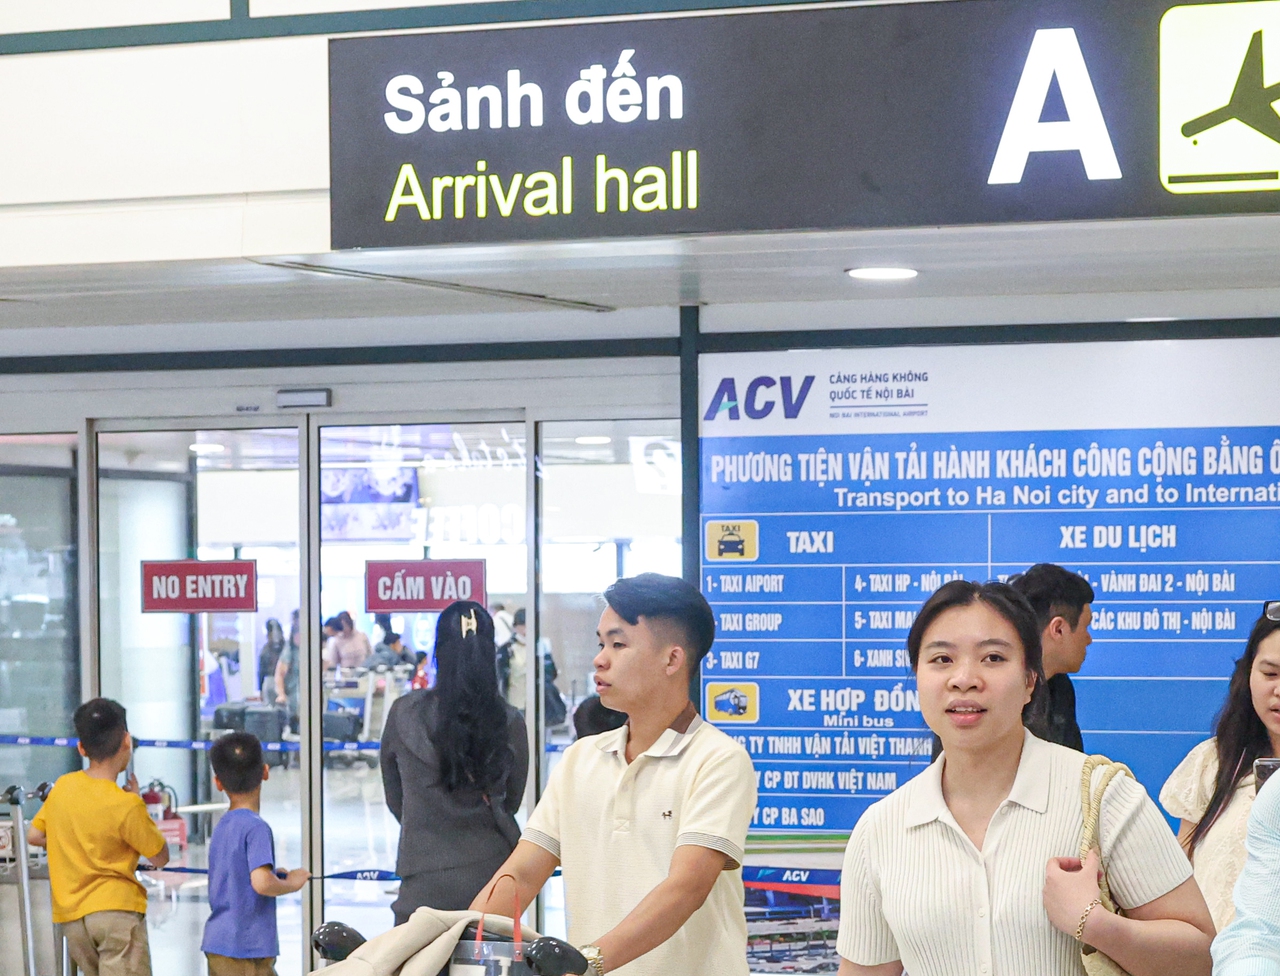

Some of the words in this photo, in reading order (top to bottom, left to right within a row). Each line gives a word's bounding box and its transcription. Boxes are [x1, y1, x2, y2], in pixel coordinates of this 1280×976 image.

[383, 70, 544, 134] Sảnh
[564, 49, 684, 126] đến
[986, 28, 1122, 186] A
[384, 156, 574, 224] Arrival
[594, 151, 699, 212] hall
[829, 371, 857, 384] CẢNG
[860, 371, 889, 384] HÀNG
[892, 369, 928, 382] KHÔNG
[703, 376, 816, 421] ACV
[829, 386, 857, 402] QUỐC
[860, 385, 872, 399] TẾ
[875, 386, 893, 401] NỘI
[897, 386, 914, 398] BÀI
[711, 451, 793, 483] PHƯƠNG
[798, 447, 843, 488] TIỆN
[849, 446, 890, 487] VẬN
[894, 441, 927, 480] TẢI
[933, 444, 990, 480] HÀNH
[995, 443, 1067, 478] KHÁCH
[1072, 442, 1131, 478] CÔNG
[1137, 440, 1197, 483] CỘNG
[1202, 434, 1264, 476] BẰNG
[833, 487, 941, 511] Transport
[947, 487, 970, 506] to
[976, 486, 1006, 506] Ha
[1013, 485, 1050, 505] Noi
[1057, 484, 1099, 509] city
[1106, 483, 1148, 504] and
[1155, 484, 1179, 503] to
[721, 524, 741, 532] TAXI
[1060, 526, 1087, 548] XE
[1093, 525, 1123, 548] DU
[1128, 525, 1177, 553] LỊCH
[786, 531, 834, 554] TAXI
[152, 576, 180, 598] NO
[186, 574, 248, 598] ENTRY
[378, 569, 424, 601] CẤM
[430, 571, 472, 601] VÀO
[720, 575, 743, 592] TAXI
[745, 574, 784, 592] AIPORT
[869, 574, 892, 592] TAXI
[895, 574, 910, 592] HP
[1101, 570, 1137, 592] VÀNH
[1139, 573, 1162, 592] ĐAI
[1164, 573, 1174, 592] 2
[1185, 570, 1209, 596] NỘI
[1212, 570, 1235, 592] BÀI
[720, 613, 743, 632] TAXI
[745, 613, 782, 632] GROUP
[868, 611, 893, 629] TAXI
[1091, 608, 1115, 631] CÁC
[1117, 611, 1141, 630] KHU
[1143, 608, 1160, 630] ĐÔ
[1162, 611, 1181, 634] THỊ
[1191, 608, 1212, 634] NỘI
[1215, 608, 1236, 630] BÀI
[720, 652, 743, 670] TAXI
[745, 651, 760, 669] G7
[866, 649, 894, 668] XANH
[787, 689, 816, 712] XE
[820, 687, 866, 716] HỢP
[874, 682, 921, 712] ĐỒN
[823, 715, 859, 728] Mini
[862, 715, 894, 728] bus
[749, 736, 764, 754] TY
[767, 736, 802, 755] TNHH
[804, 733, 831, 758] VẬN
[834, 731, 854, 756] TẢI
[858, 733, 886, 760] VIỆT
[889, 737, 933, 756] THANH
[764, 771, 781, 789] CP
[784, 771, 800, 790] ĐT
[802, 771, 835, 790] DVHK
[837, 768, 864, 794] VIỆT
[866, 772, 897, 790] NAM
[762, 807, 779, 826] CP
[782, 808, 798, 826] BA
[801, 808, 825, 826] SAO
[782, 871, 810, 882] ACV
